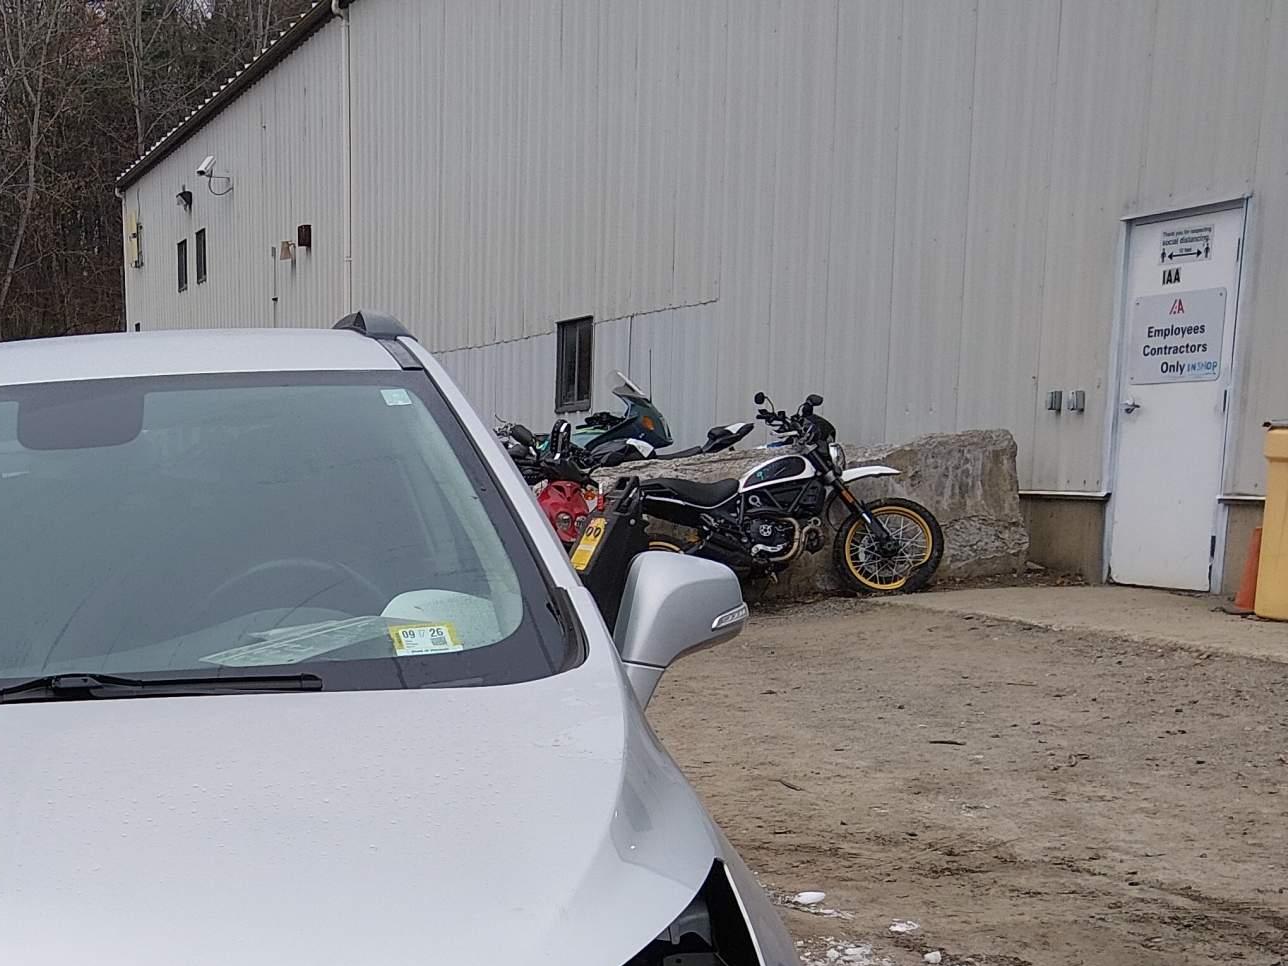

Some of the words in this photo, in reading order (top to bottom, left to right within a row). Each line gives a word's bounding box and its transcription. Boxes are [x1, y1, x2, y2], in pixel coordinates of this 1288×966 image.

[1162, 268, 1180, 285] IAA
[1147, 324, 1206, 340] Employees
[1143, 343, 1208, 356] Contractors
[1160, 360, 1186, 376] Only
[402, 630, 415, 638] 09
[429, 628, 443, 637] 26
